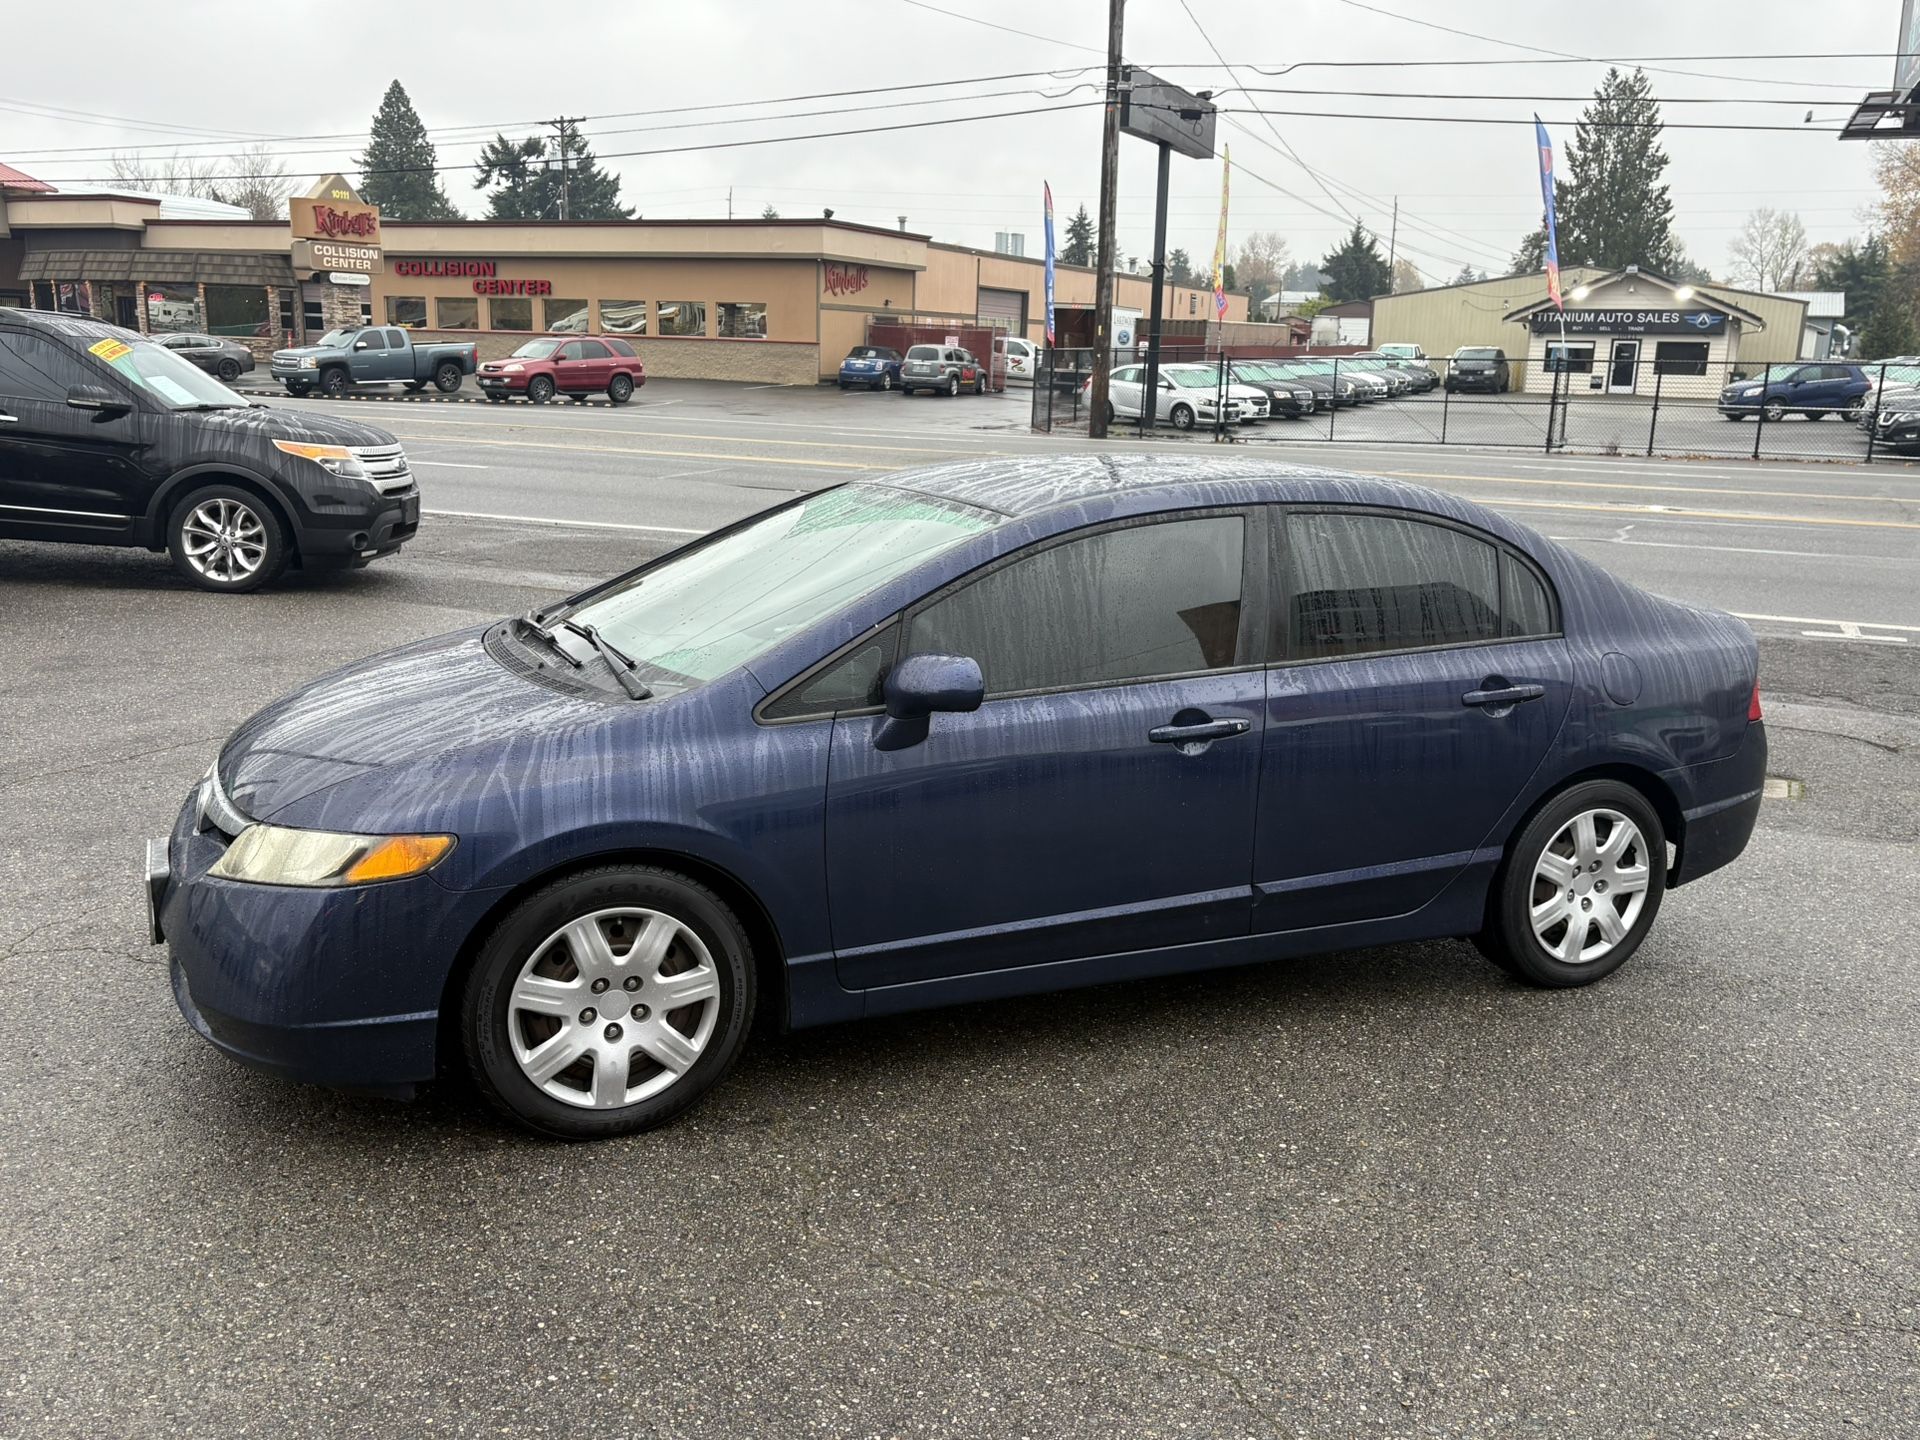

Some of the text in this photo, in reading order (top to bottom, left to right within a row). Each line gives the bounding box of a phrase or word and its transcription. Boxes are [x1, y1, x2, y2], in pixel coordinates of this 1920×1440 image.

[331, 189, 350, 199] 10111
[314, 245, 379, 260] COLLISION
[323, 257, 372, 270] CENTER
[395, 260, 496, 278] COLLISION
[473, 279, 551, 295] CENTER
[1536, 312, 1680, 324] TITANIUM AUTO SALES
